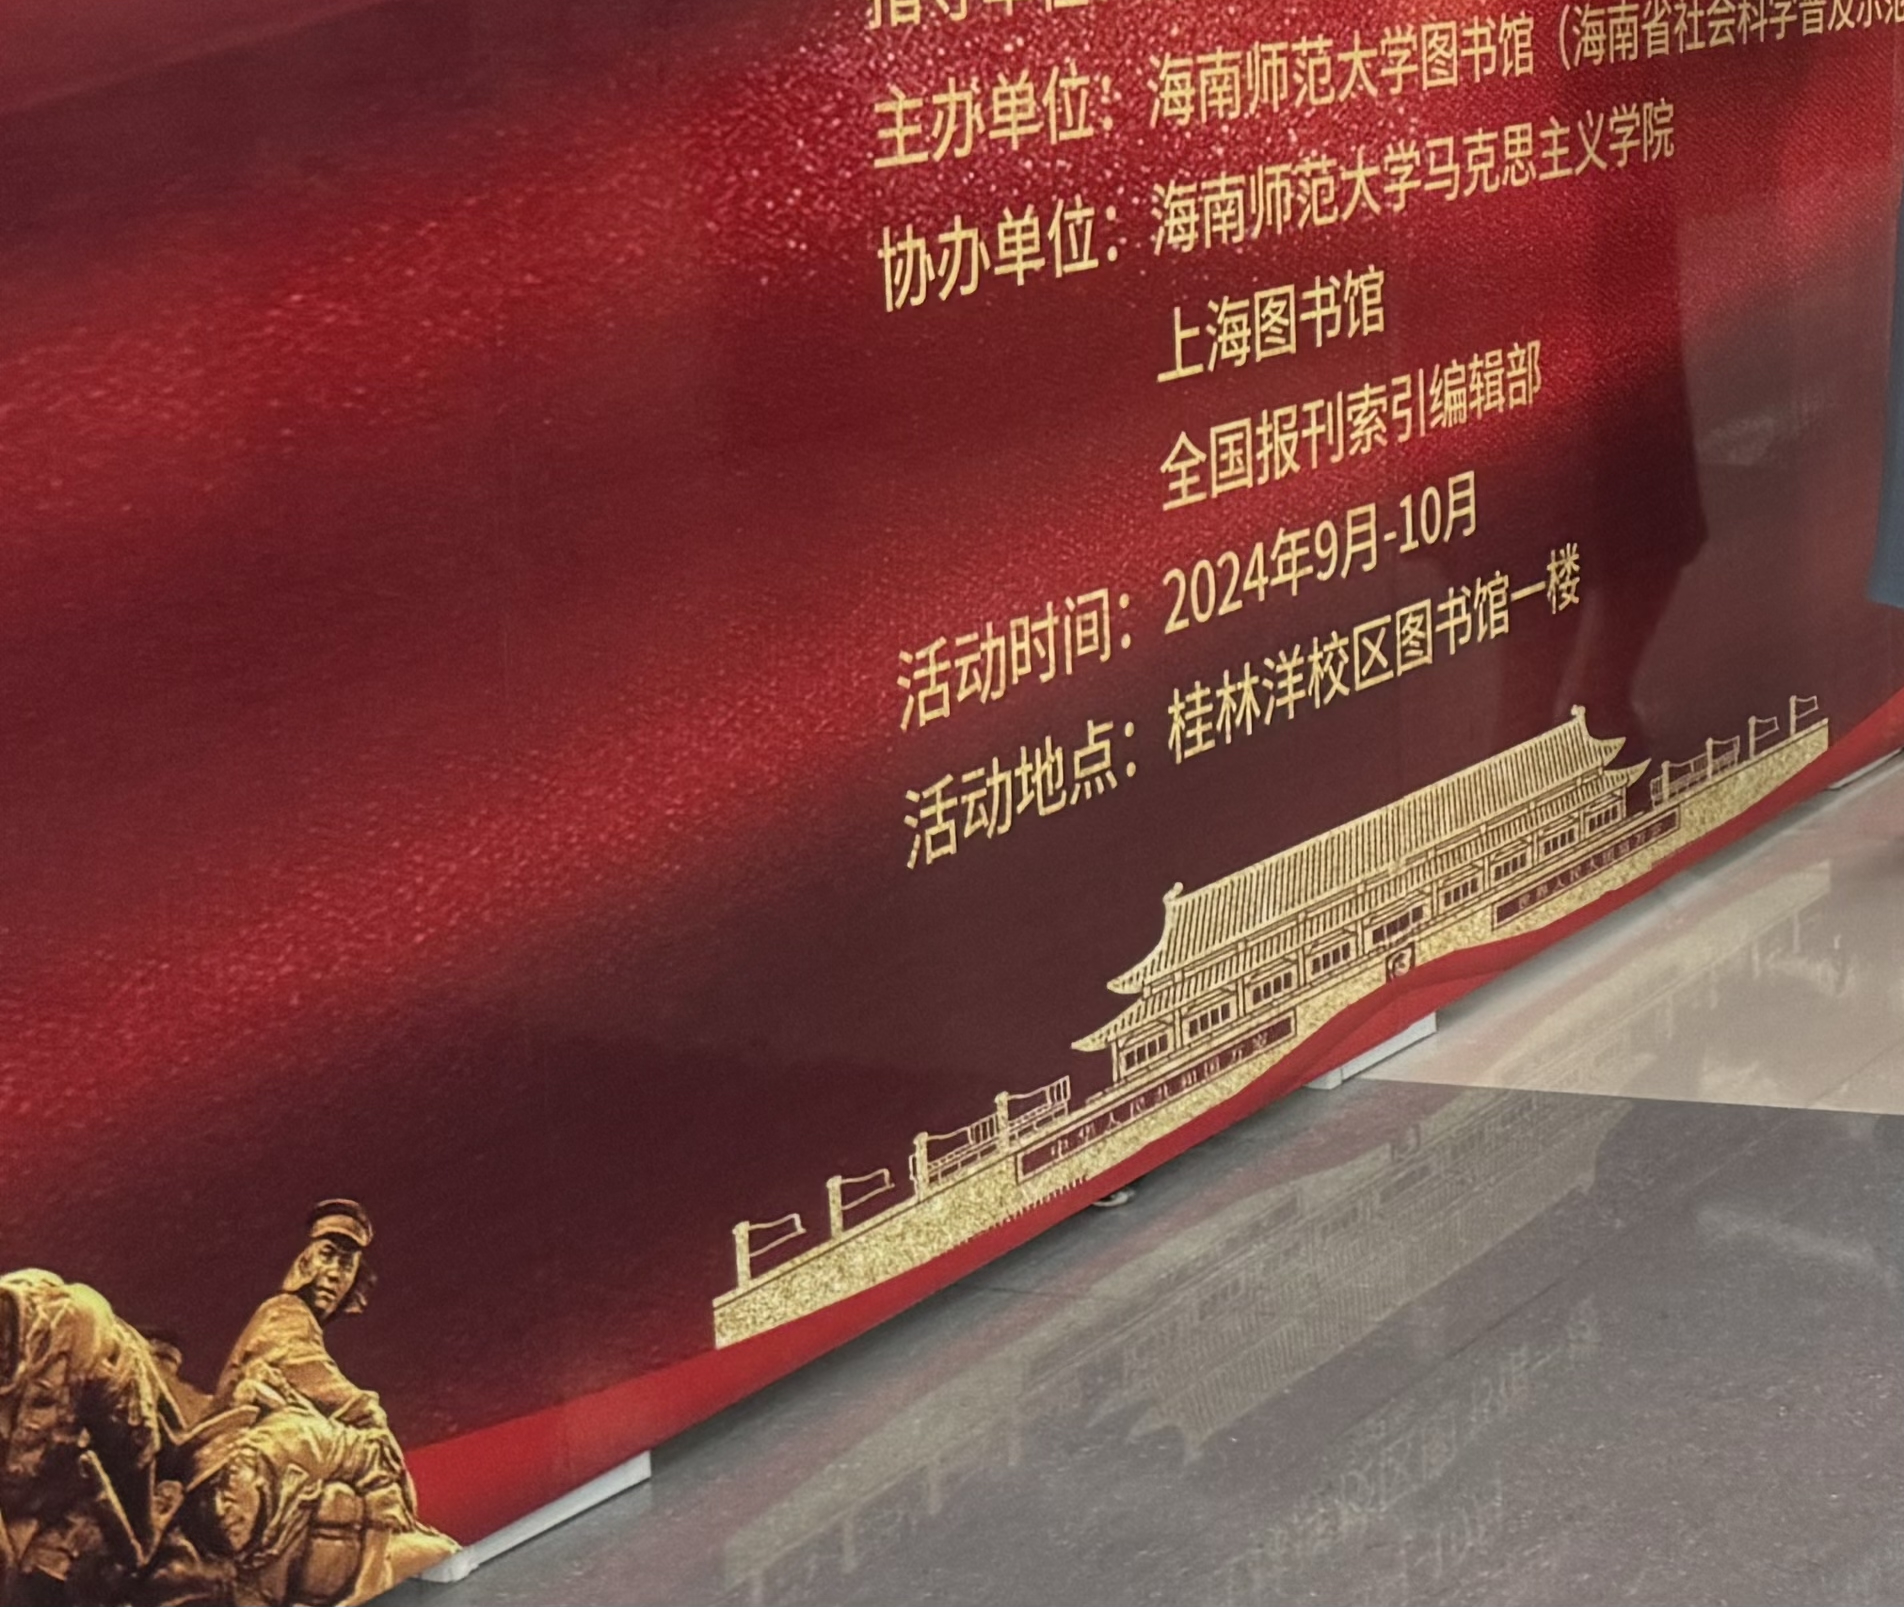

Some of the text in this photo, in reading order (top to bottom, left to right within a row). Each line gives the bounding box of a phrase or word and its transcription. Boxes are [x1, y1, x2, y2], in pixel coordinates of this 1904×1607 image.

[1156, 263, 1387, 384] 上海图书馆
[1159, 339, 1543, 512] 全国报刊索引编辑部
